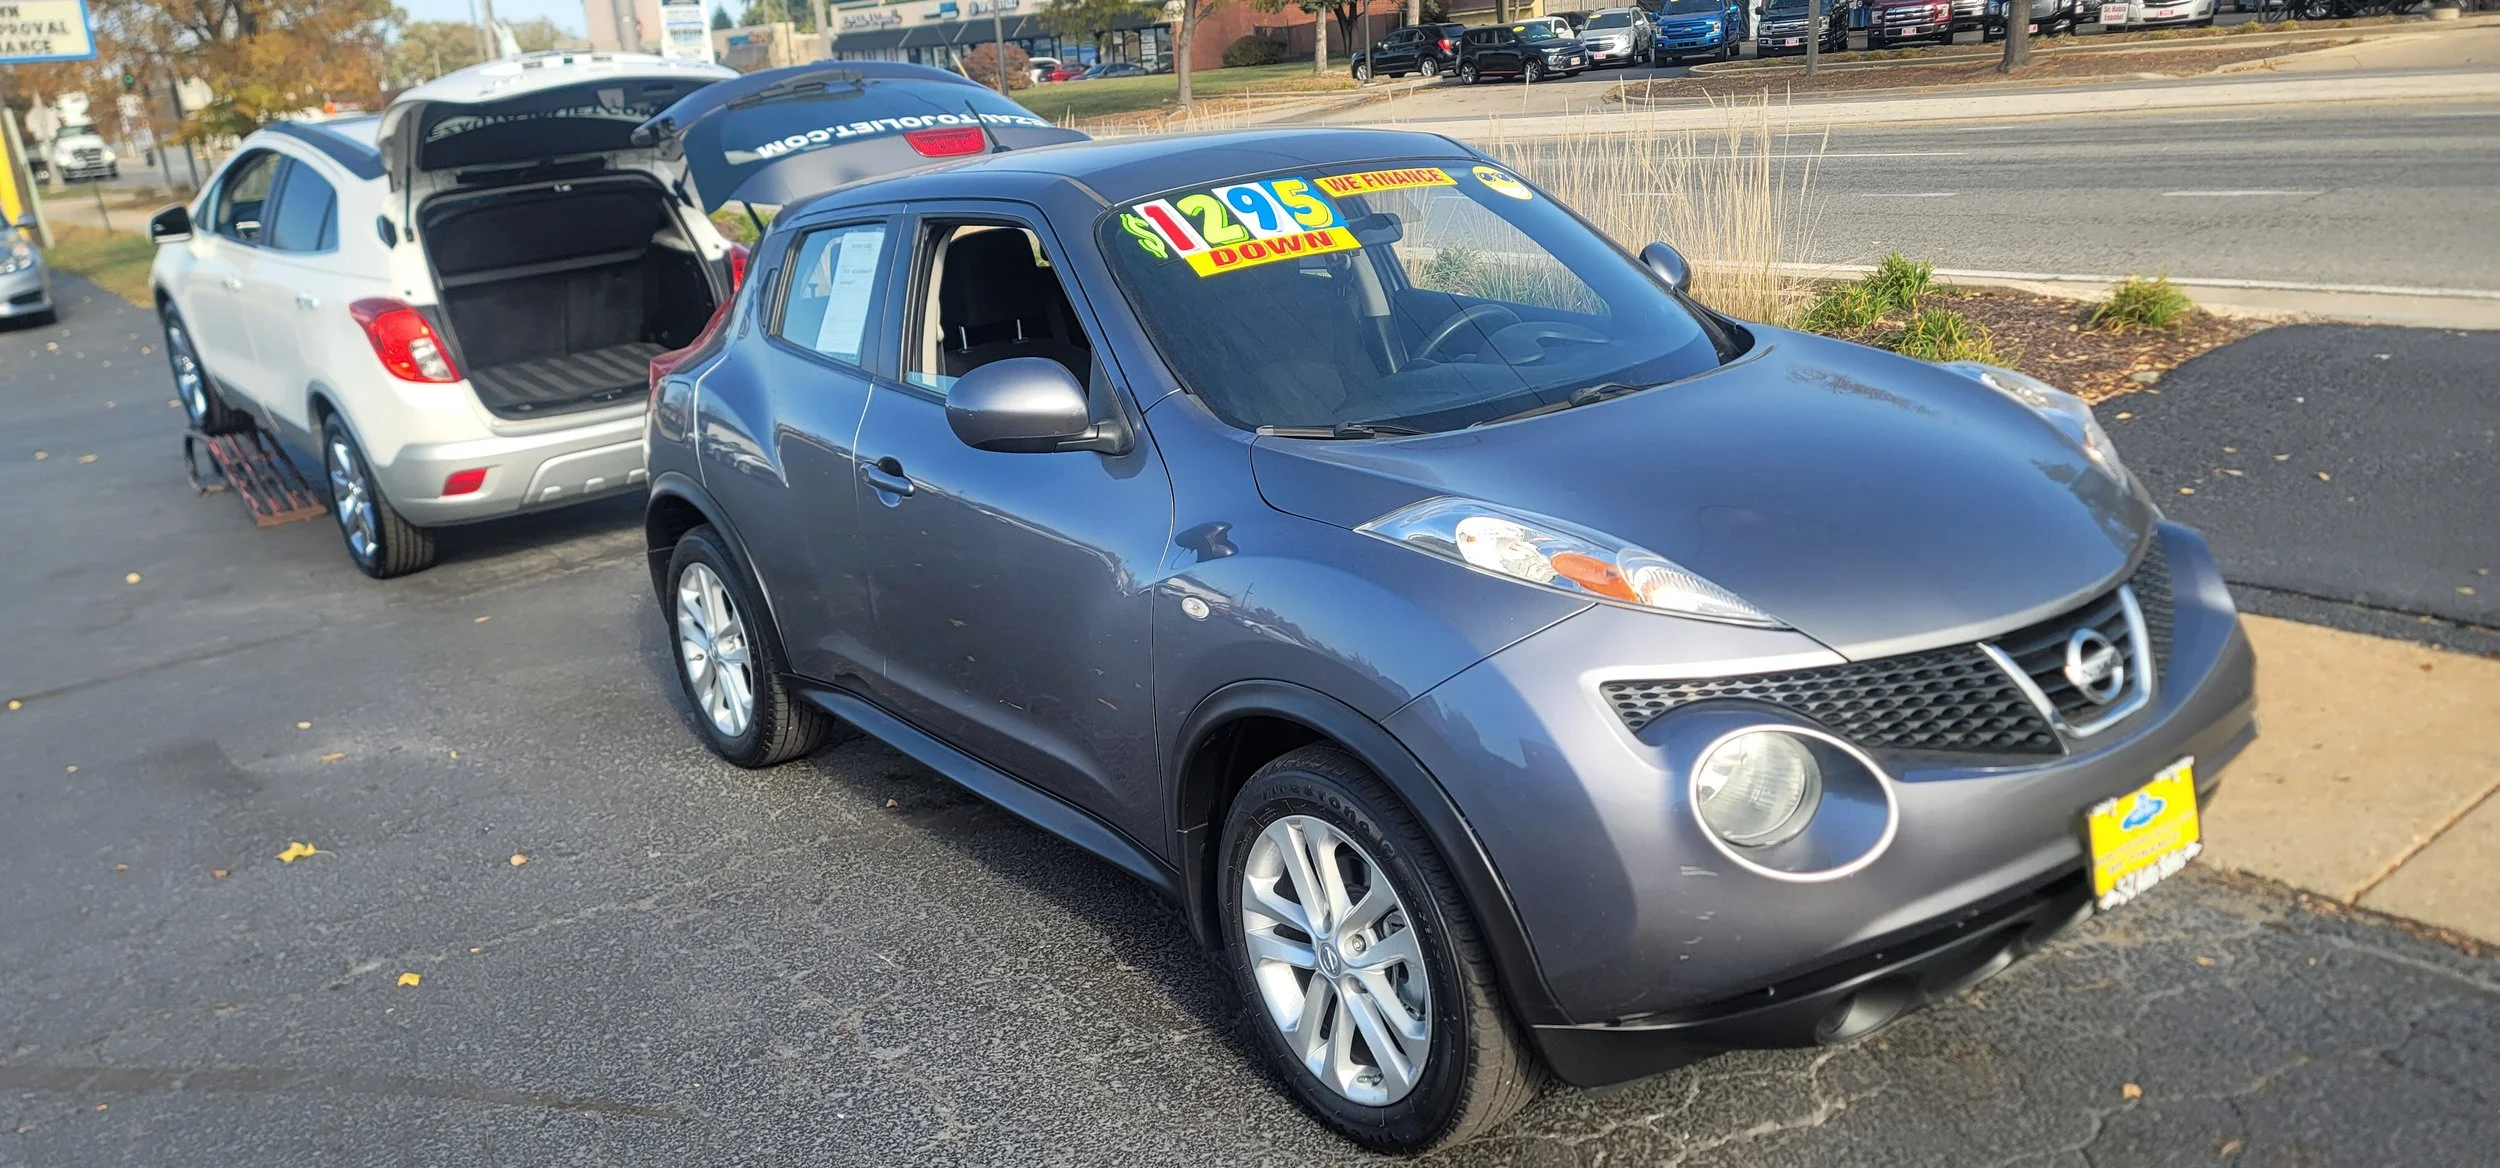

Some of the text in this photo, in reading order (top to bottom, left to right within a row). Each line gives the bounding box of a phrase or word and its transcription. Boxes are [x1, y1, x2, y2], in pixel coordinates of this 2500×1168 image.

[0, 39, 53, 54] ANCE
[1324, 168, 1445, 194] WE FINANCE
[1119, 178, 1334, 260] $1295
[1208, 230, 1337, 268] DOWN
